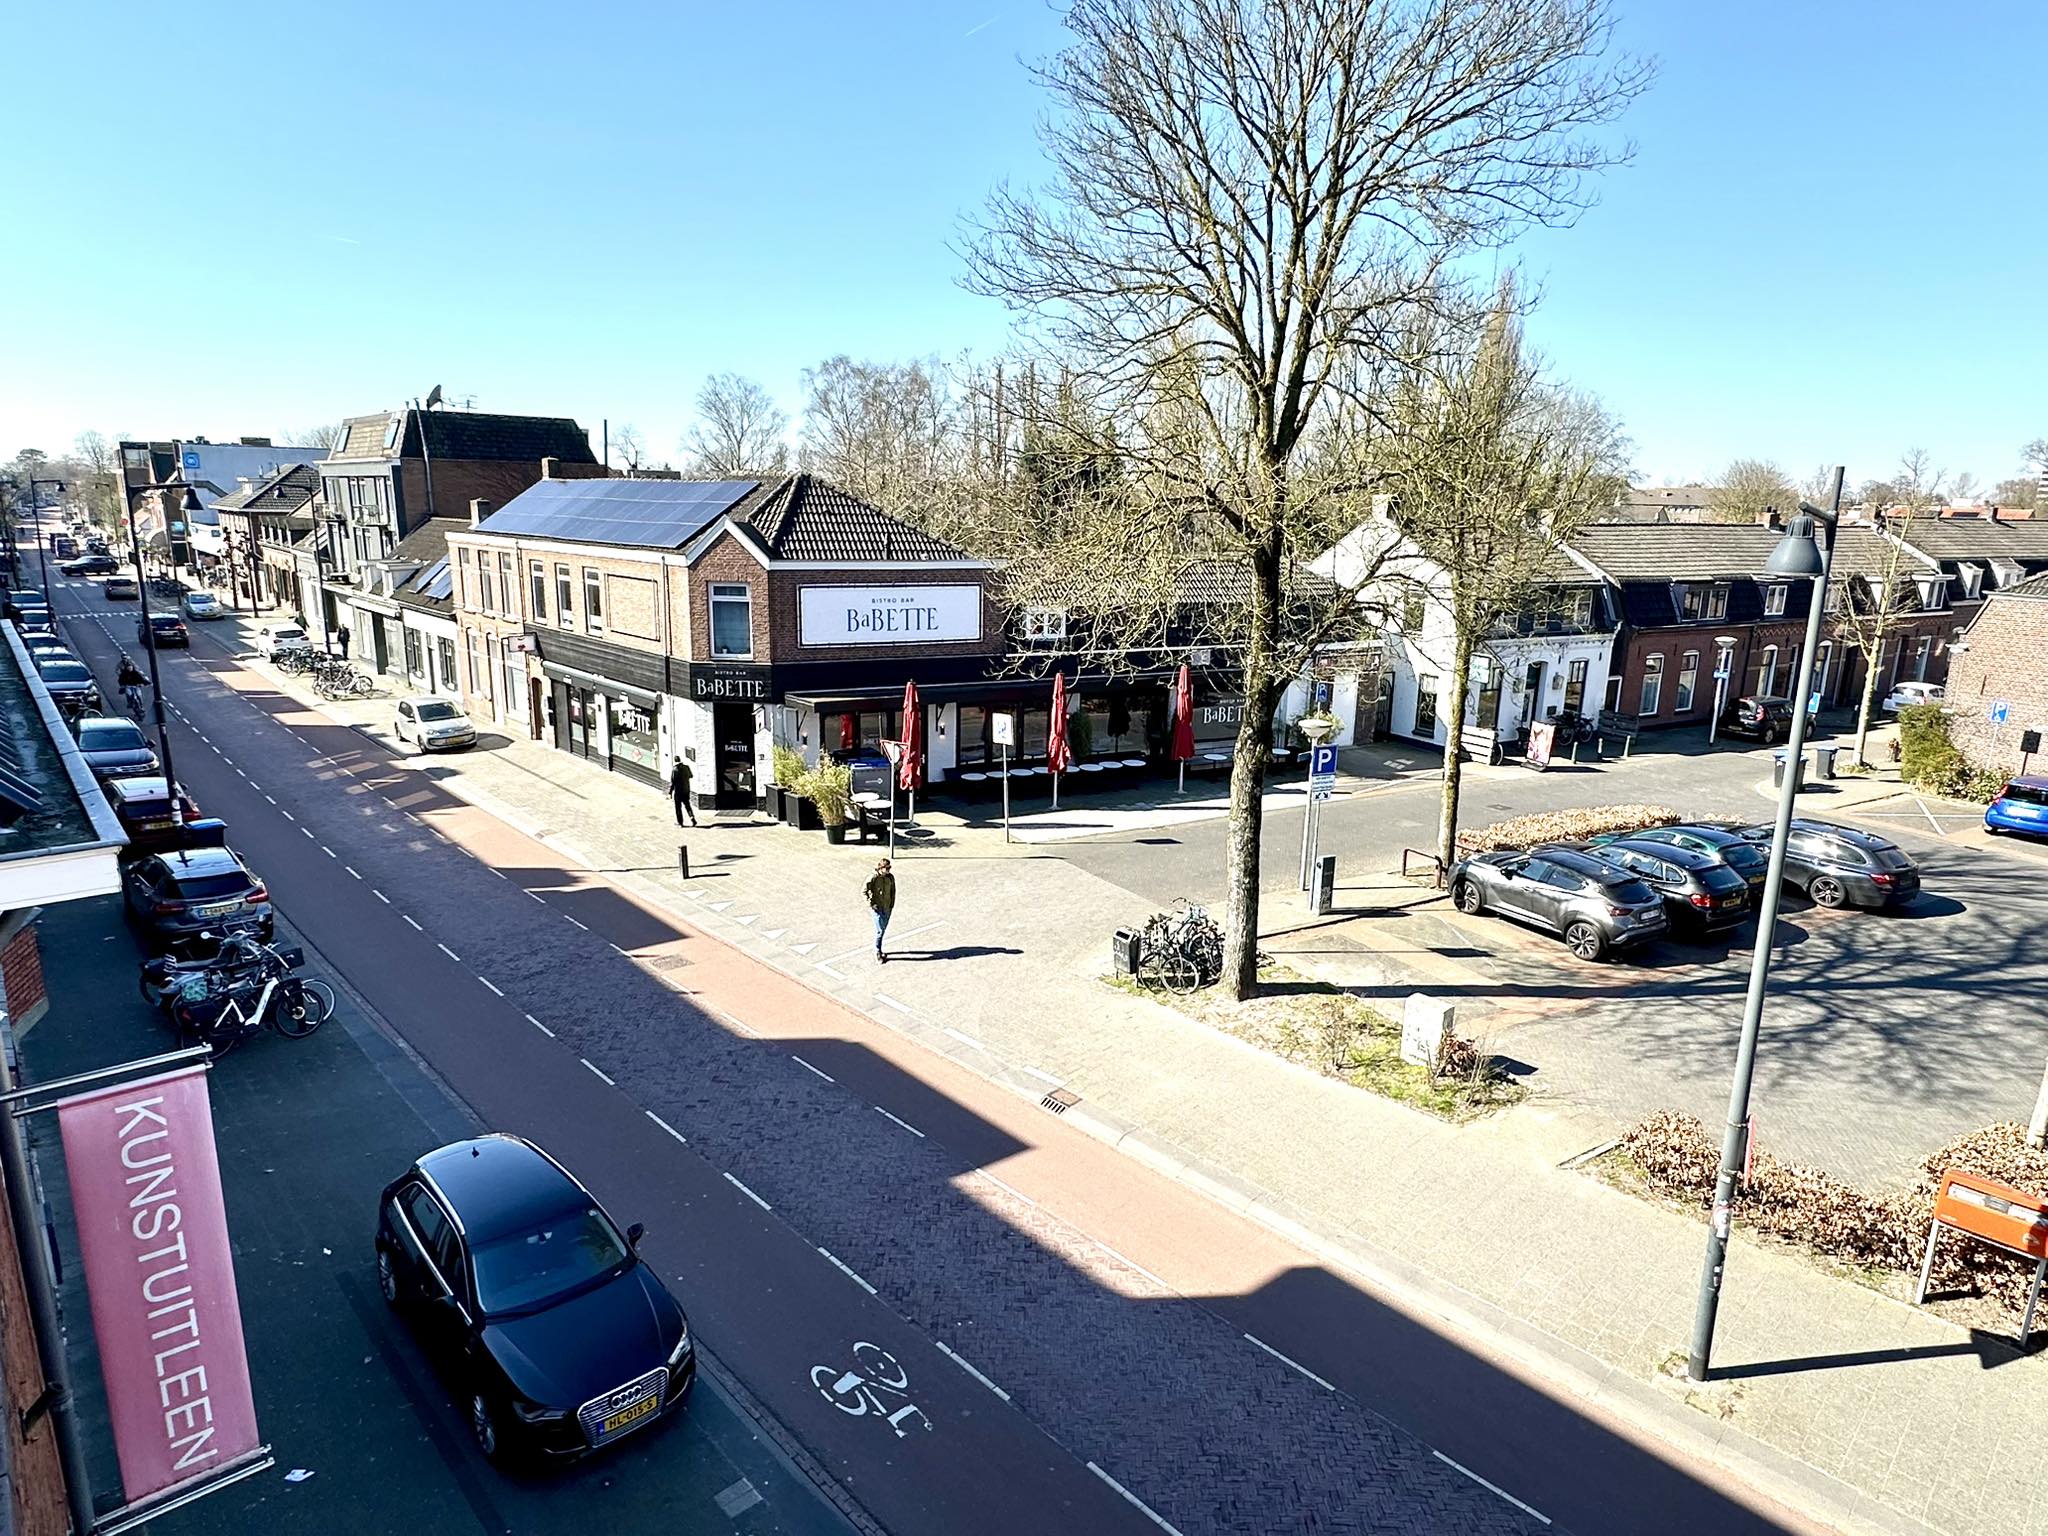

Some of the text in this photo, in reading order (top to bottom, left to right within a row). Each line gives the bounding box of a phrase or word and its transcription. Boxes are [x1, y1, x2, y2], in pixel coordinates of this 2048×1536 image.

[847, 607, 939, 632] BaBETTE
[696, 678, 765, 697] BaBETTE
[1203, 705, 1246, 724] BaBET
[1317, 749, 1333, 772] P
[114, 1095, 219, 1471] KUNSTUITLEEN
[608, 1399, 654, 1429] HL-015-S
